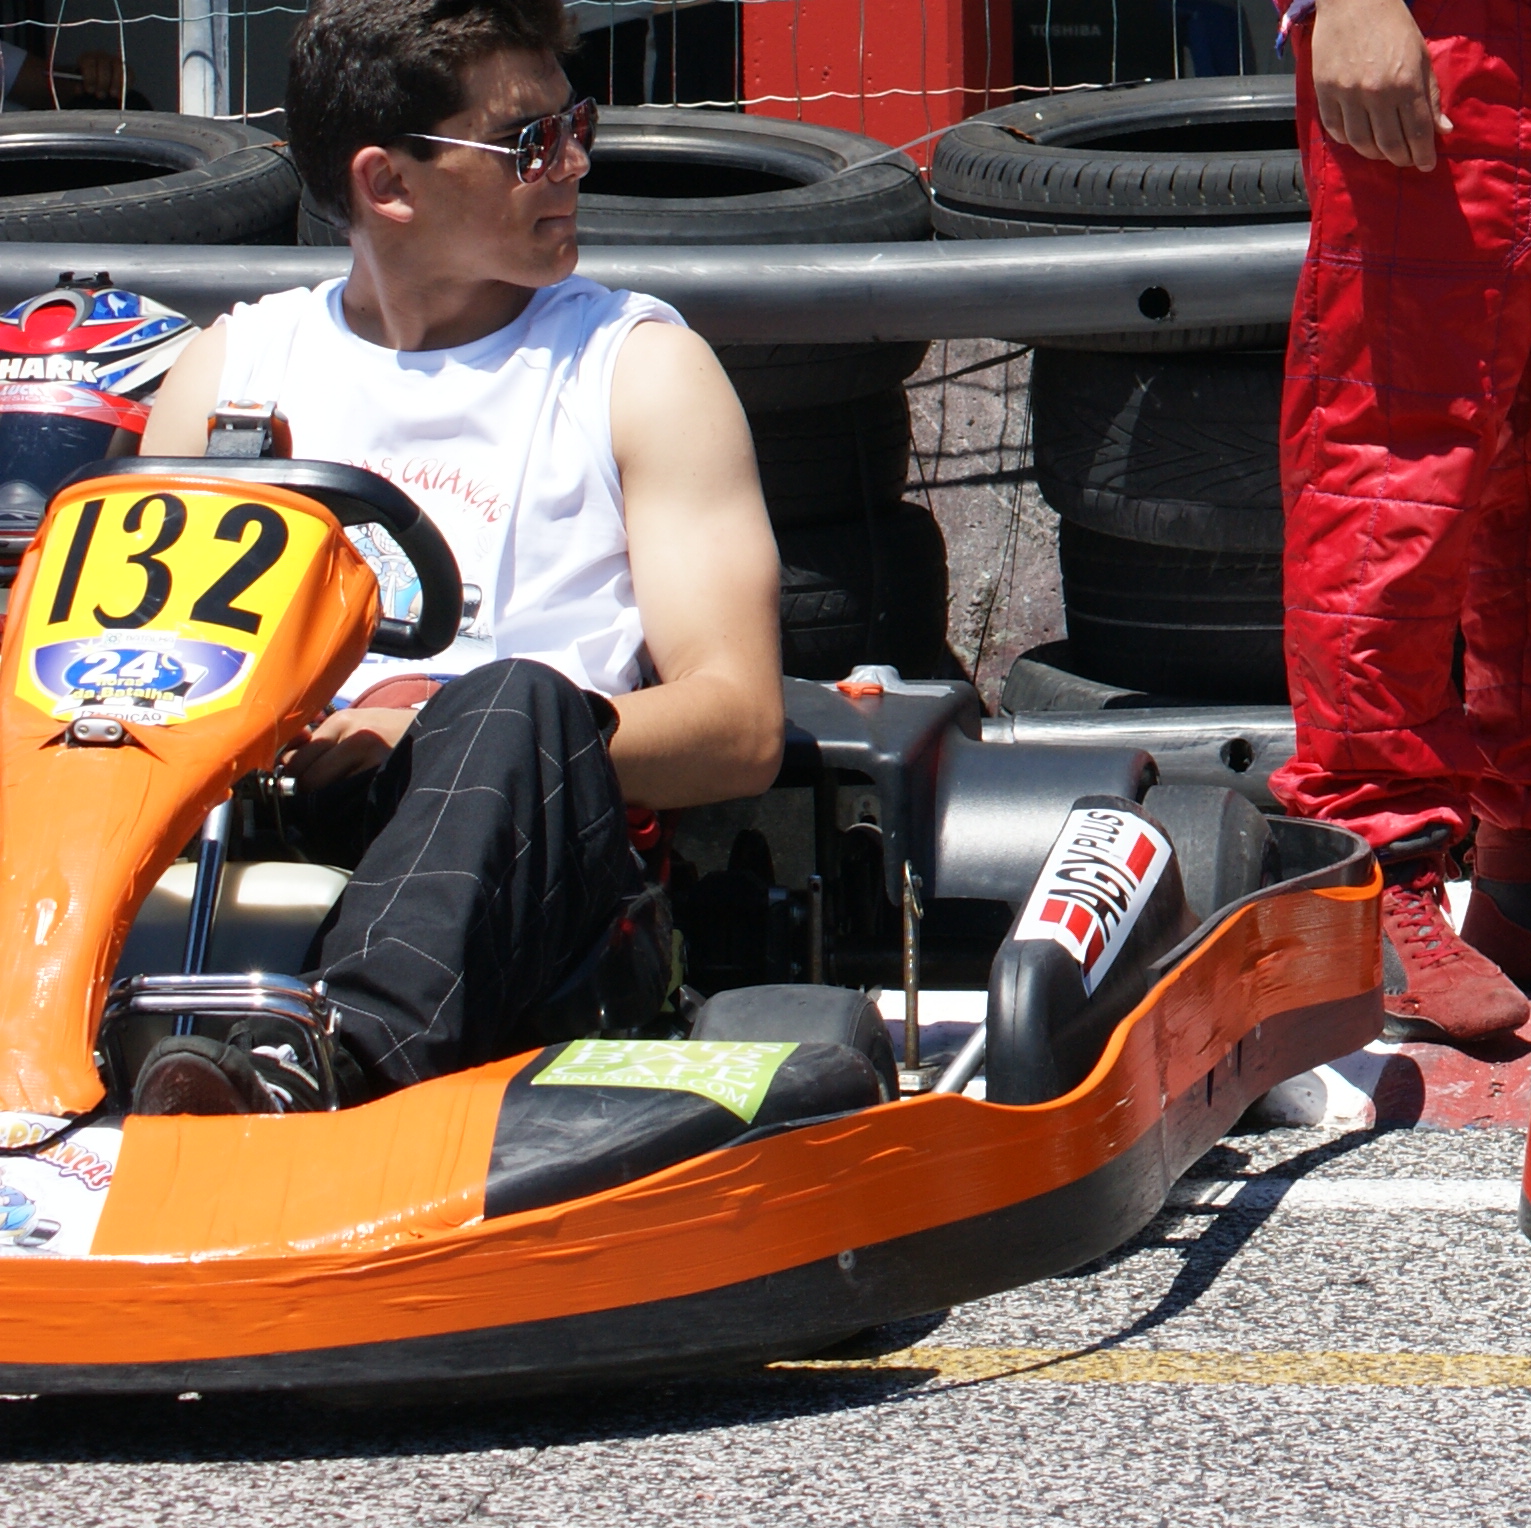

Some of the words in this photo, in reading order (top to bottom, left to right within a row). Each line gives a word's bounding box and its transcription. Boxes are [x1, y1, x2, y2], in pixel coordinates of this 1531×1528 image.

[1030, 24, 1101, 36] TOSHIBA
[47, 492, 289, 636] 132
[80, 650, 159, 684] 24
[72, 688, 95, 700] da
[101, 687, 175, 701] Batalha
[1072, 811, 1125, 853] PLUS
[572, 1052, 765, 1066] BAR
[577, 1041, 784, 1054] PINUS
[545, 1074, 750, 1109] PINUSBAR.COM
